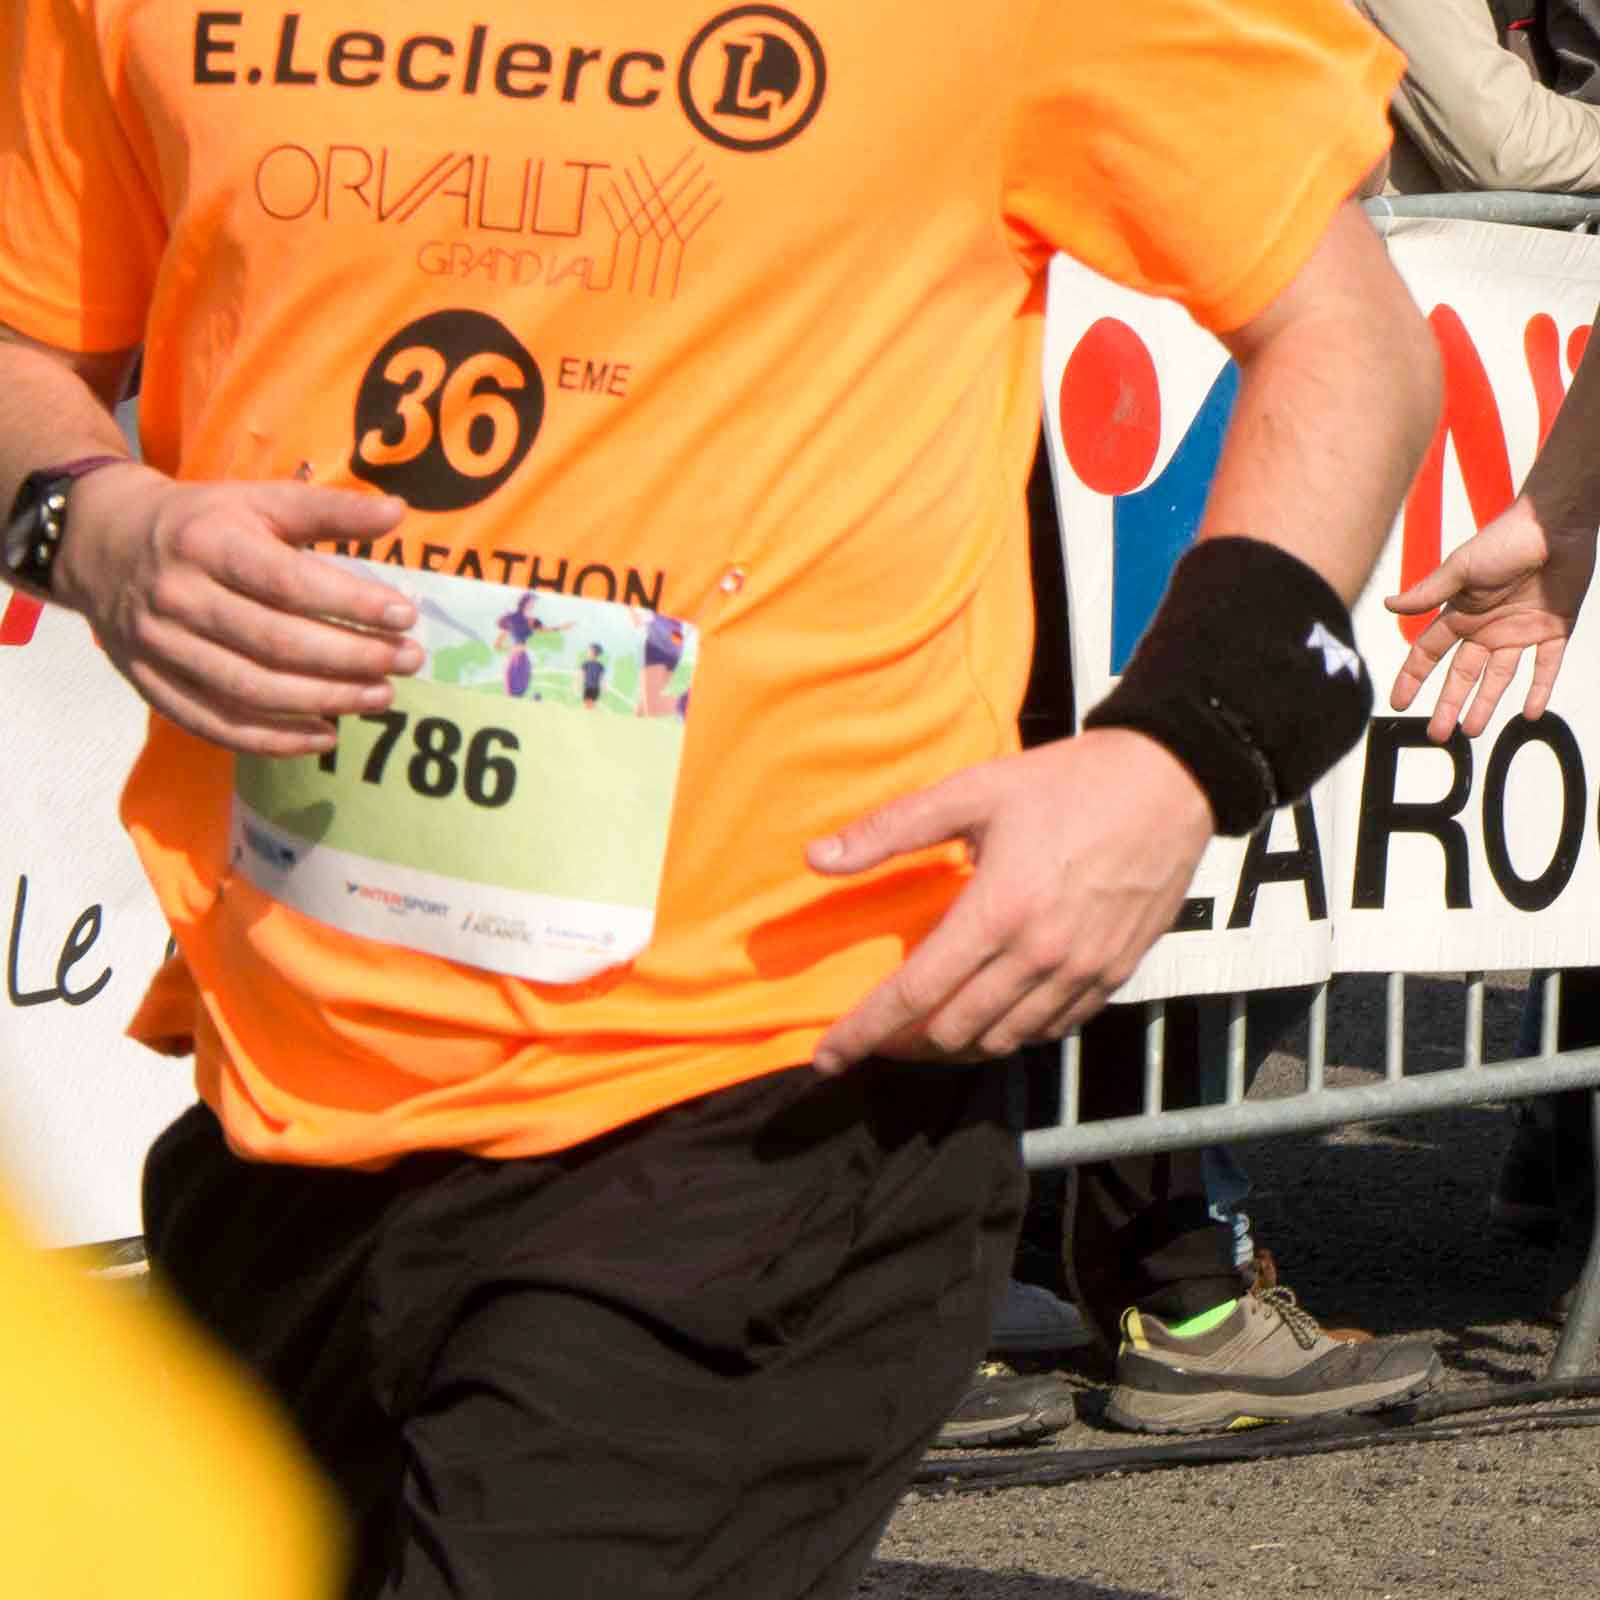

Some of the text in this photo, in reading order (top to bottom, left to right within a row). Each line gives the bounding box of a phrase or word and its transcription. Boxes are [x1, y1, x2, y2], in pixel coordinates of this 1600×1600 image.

[192, 11, 665, 109] E.Leclerc
[254, 143, 611, 237] ORVAULT
[358, 345, 634, 478] 36 EME
[7, 873, 113, 1006] Le
